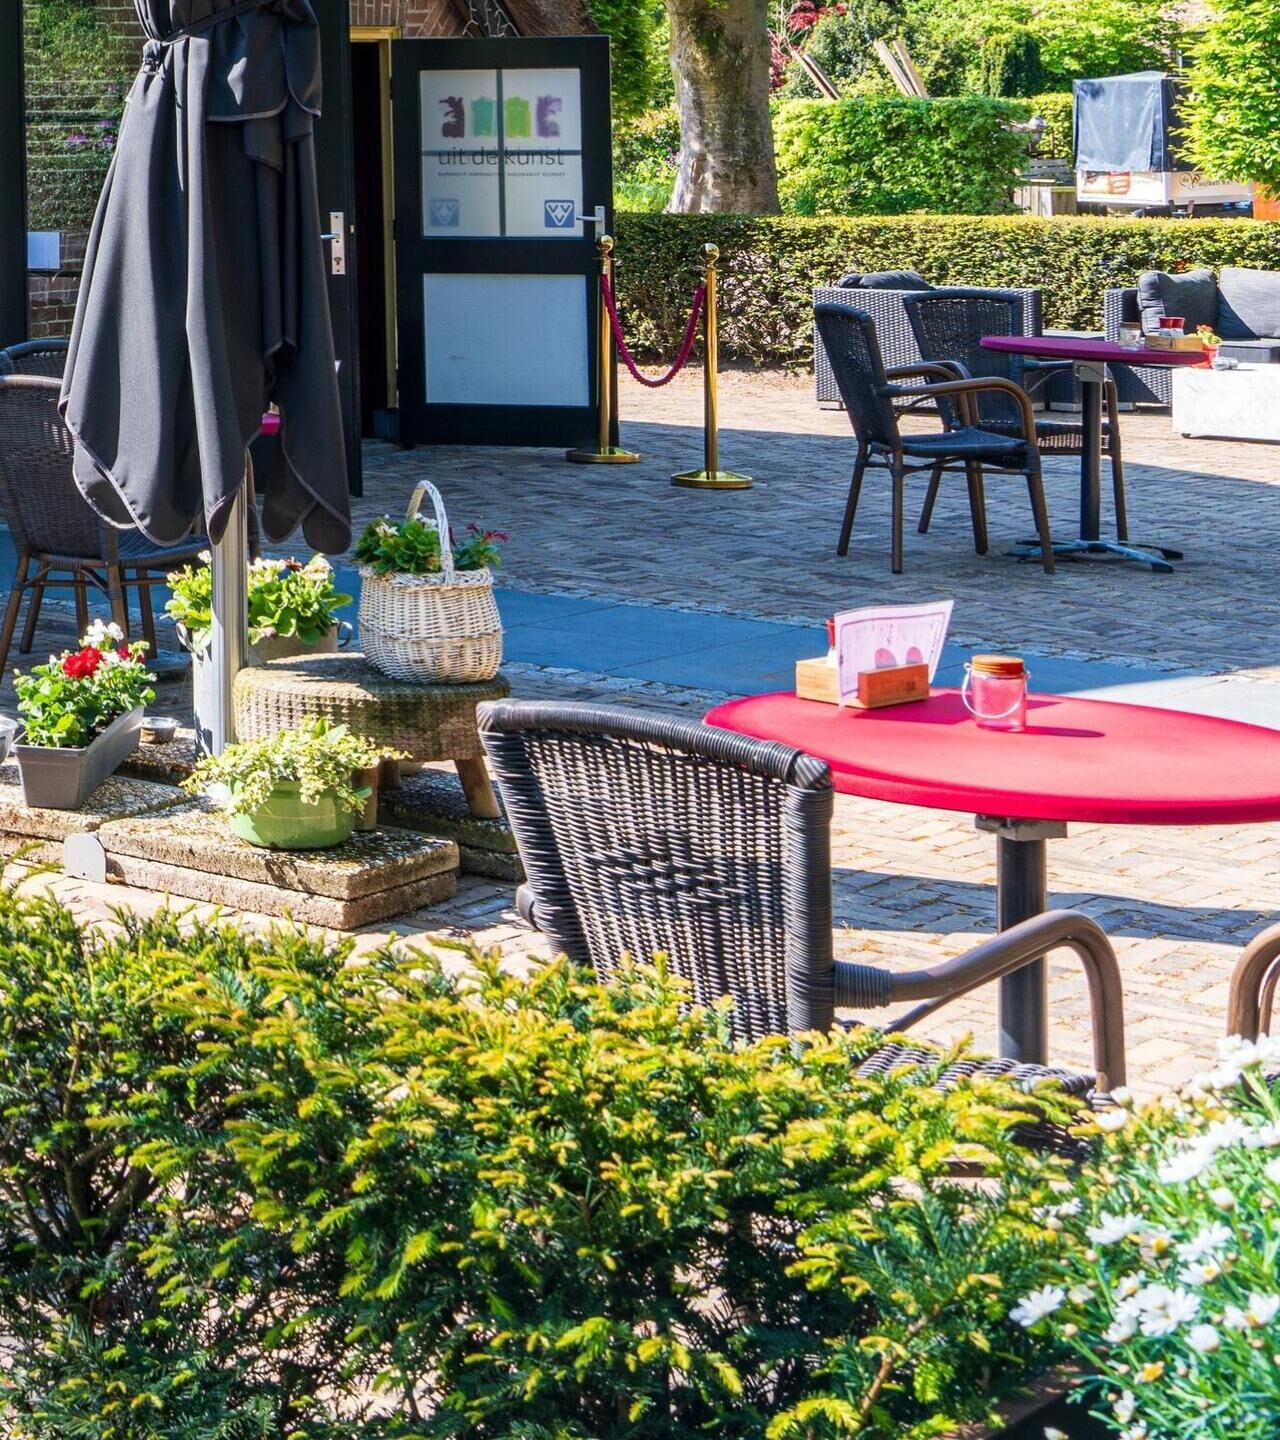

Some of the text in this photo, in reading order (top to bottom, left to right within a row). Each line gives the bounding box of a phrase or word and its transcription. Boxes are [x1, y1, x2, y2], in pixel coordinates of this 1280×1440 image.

[438, 146, 565, 166] uit de kunst
